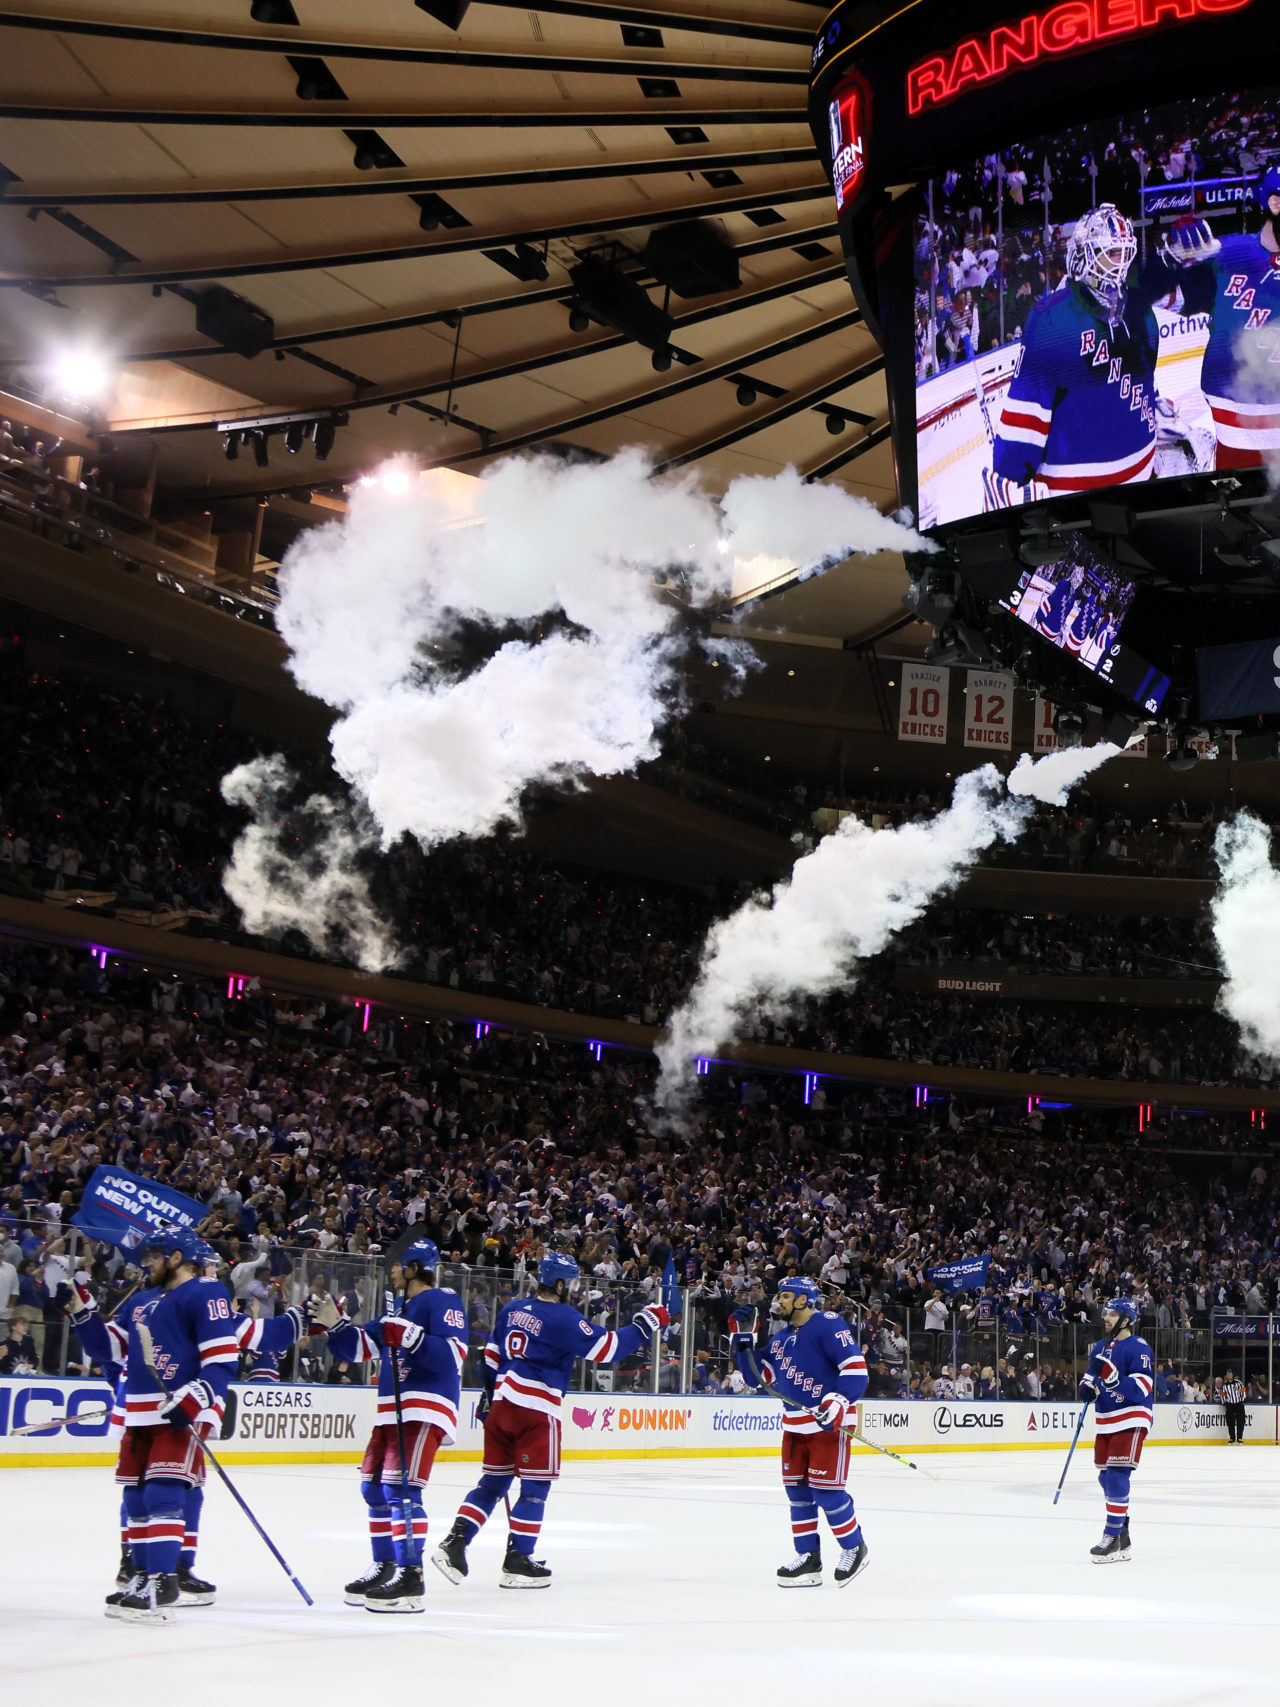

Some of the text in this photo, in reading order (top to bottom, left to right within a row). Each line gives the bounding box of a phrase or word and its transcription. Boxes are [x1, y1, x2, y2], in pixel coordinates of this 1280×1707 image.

[907, 0, 1250, 114] RANGER
[1206, 187, 1254, 203] ULTRA
[1080, 329, 1156, 433] RANGERS
[1009, 590, 1022, 606] 3
[1102, 659, 1114, 673] 2
[908, 686, 940, 718] 10
[973, 693, 1005, 725] 12
[901, 721, 945, 738] KNICKS
[967, 728, 1009, 745] KNICKS
[938, 979, 1002, 992] BUD LIGHT
[95, 1185, 172, 1229] NEW YO
[103, 1175, 194, 1226] NO QUIT IN
[207, 1298, 230, 1321] 18
[443, 1309, 465, 1329] 45
[578, 1319, 594, 1336] 8
[770, 1339, 824, 1398] RANGERS
[243, 1391, 312, 1408] CAESARS
[0, 1387, 116, 1437] ICO
[618, 1408, 692, 1431] DUNKIN'
[712, 1408, 783, 1431] ticketmast
[864, 1412, 909, 1428] BETMGM
[953, 1413, 1004, 1428] LEXUS
[240, 1413, 356, 1439] SPORTSBOOK
